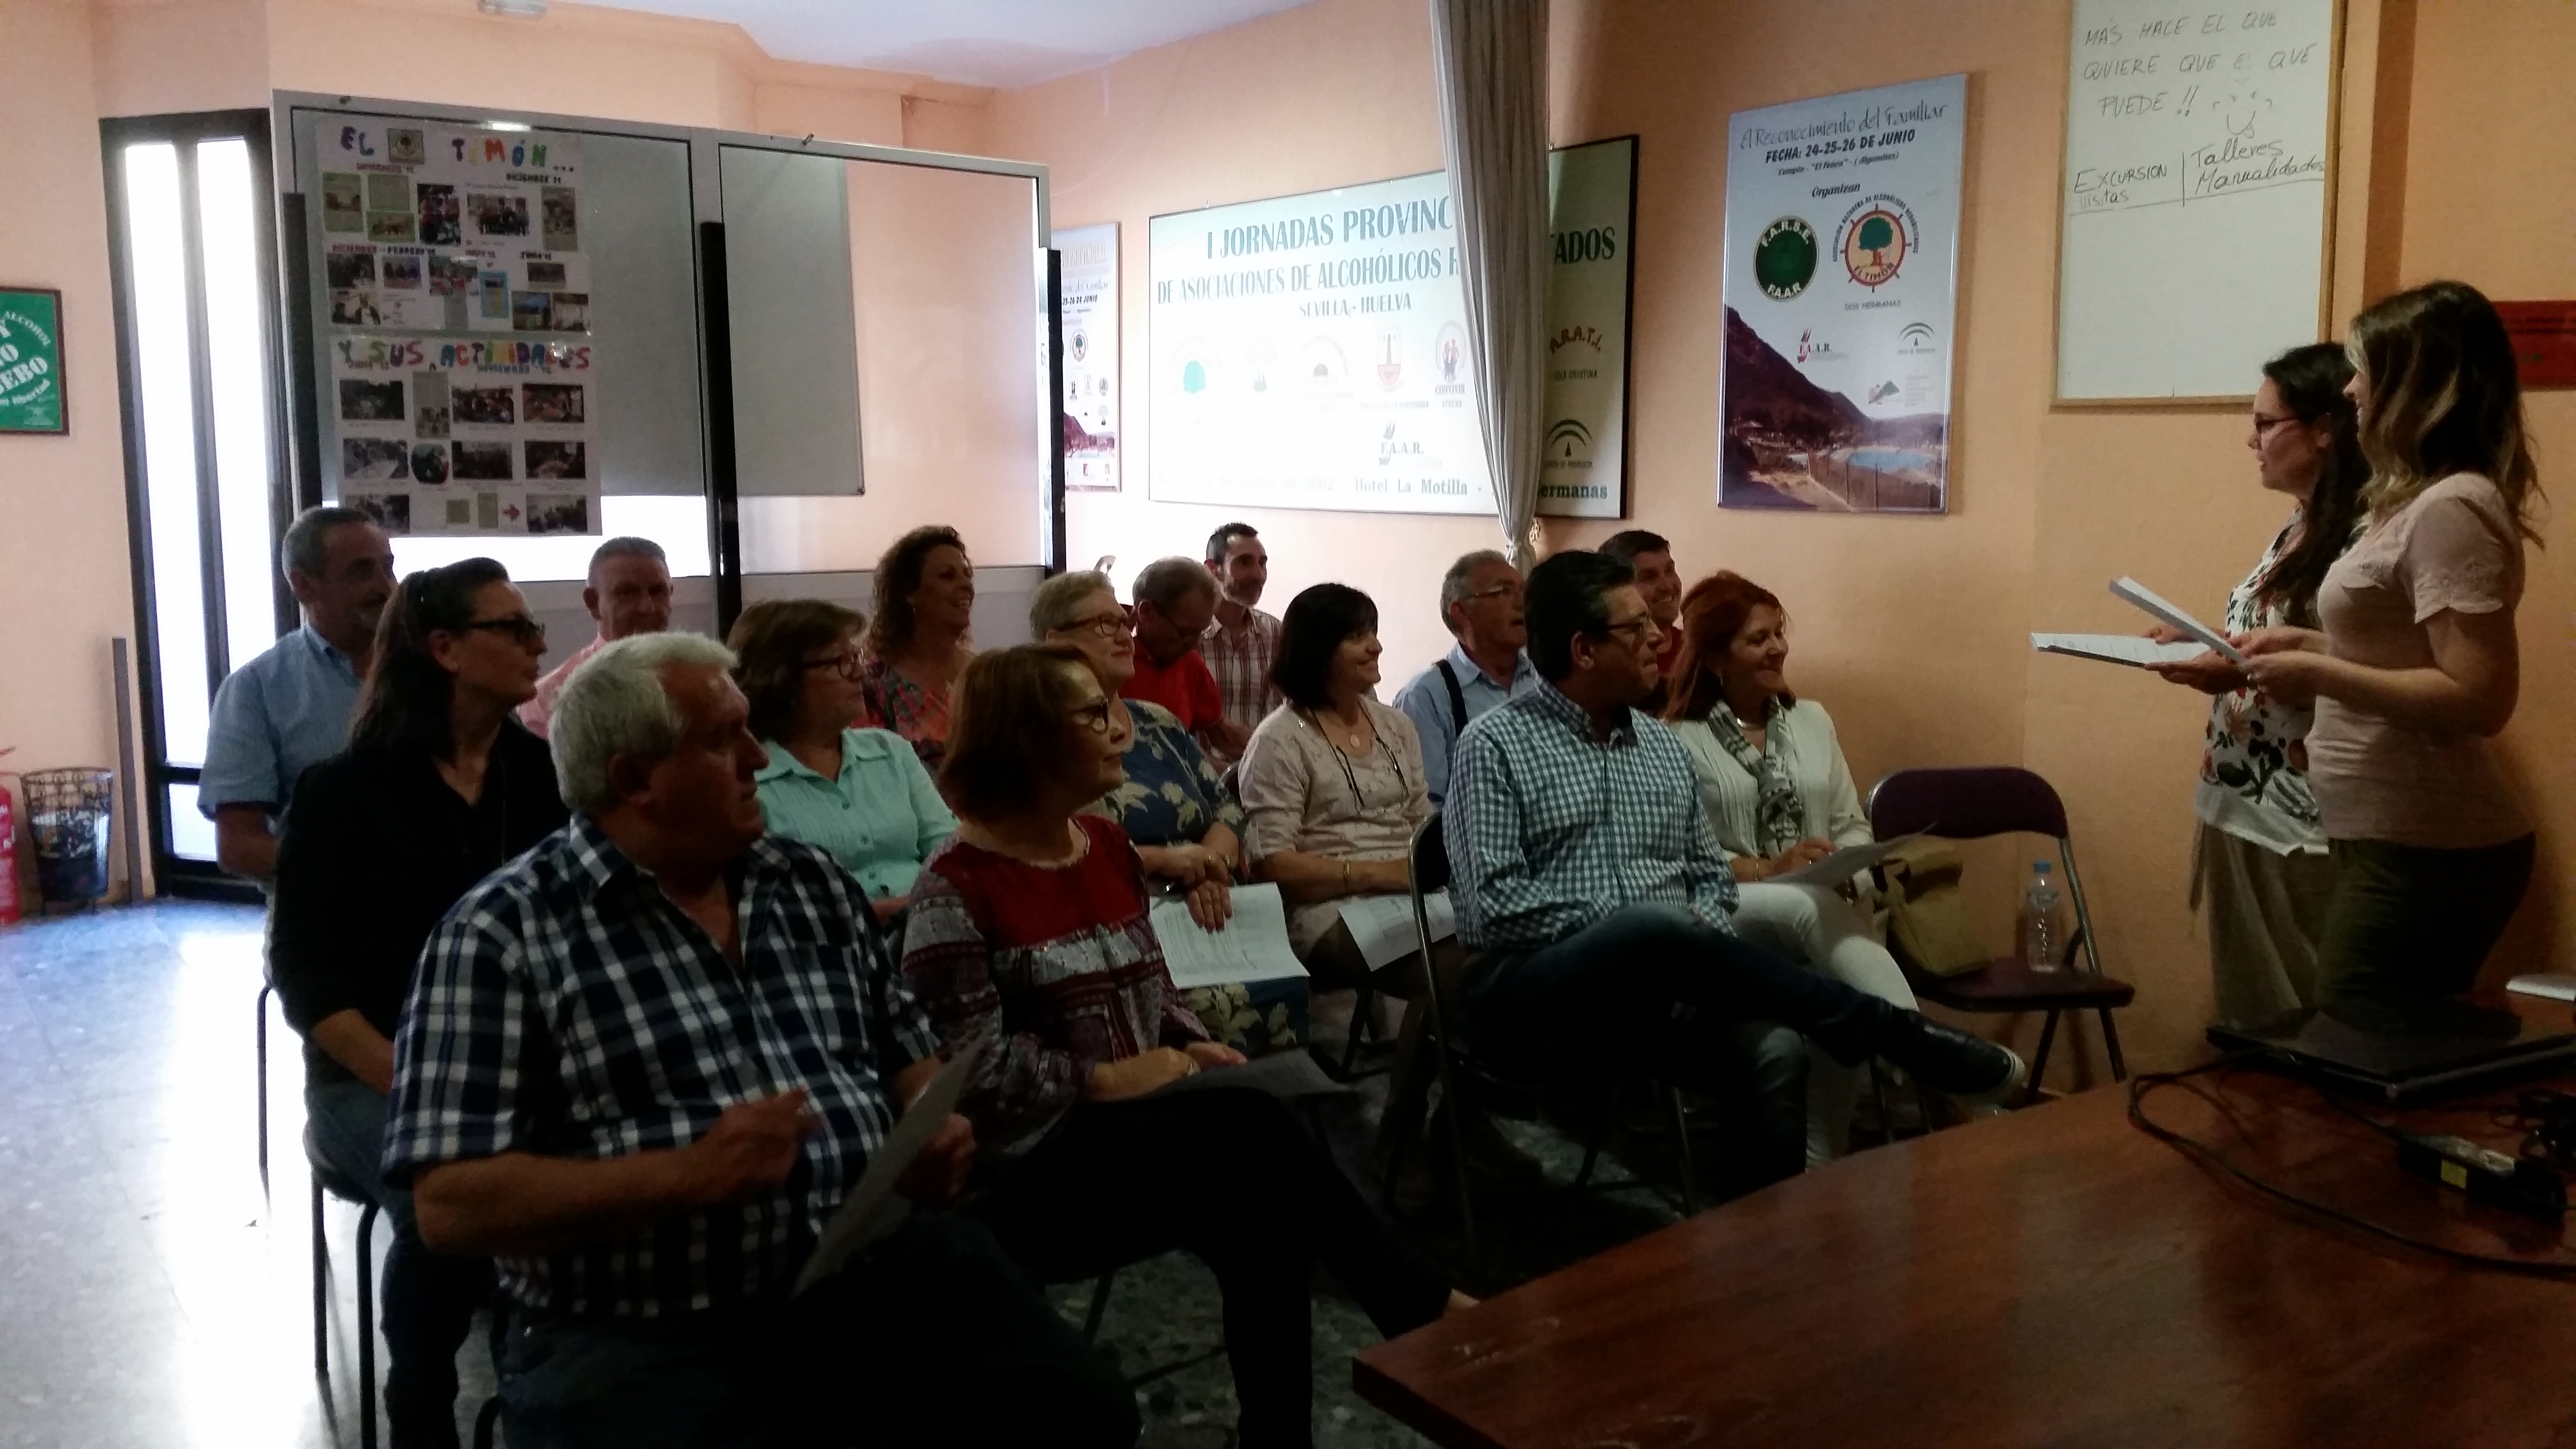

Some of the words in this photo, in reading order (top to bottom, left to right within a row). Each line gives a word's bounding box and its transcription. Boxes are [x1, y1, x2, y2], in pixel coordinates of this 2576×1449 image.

[2139, 16, 2190, 39] HACE
[2201, 15, 2225, 33] EL
[2179, 54, 2220, 72] QUE
[2268, 42, 2318, 69] QUE
[1756, 111, 1856, 146] Reconocimiento
[1858, 105, 1880, 132] del
[341, 126, 374, 156] EL
[1765, 147, 1802, 164] FECHA:
[1805, 138, 1856, 157] 24-25-26
[1860, 135, 1875, 148] DE
[1878, 129, 1916, 146] JUNIO
[2191, 138, 2283, 167] Talleres
[1812, 183, 1860, 198] Organizan
[1208, 231, 1212, 259] I
[1220, 214, 1334, 258] JORNADAS
[1344, 195, 1453, 242] PROVINC
[1550, 226, 1615, 264] ADOS
[1158, 280, 1174, 305] DE
[1179, 267, 1285, 302] ASOCIACIONES
[1292, 264, 1312, 291] DE
[1318, 248, 1441, 289] ALCOHÓLICOS
[1083, 294, 1097, 303] JUNIO
[1300, 299, 1348, 318] SEVILLA
[1361, 293, 1412, 313] HUELVA
[338, 339, 352, 363] Y
[369, 339, 424, 367] SUS
[0, 356, 48, 394] EBO
[1355, 478, 1388, 492] Hotel
[1398, 478, 1411, 493] La
[1421, 478, 1468, 496] Motilla
[1538, 485, 1608, 500] ermanas
